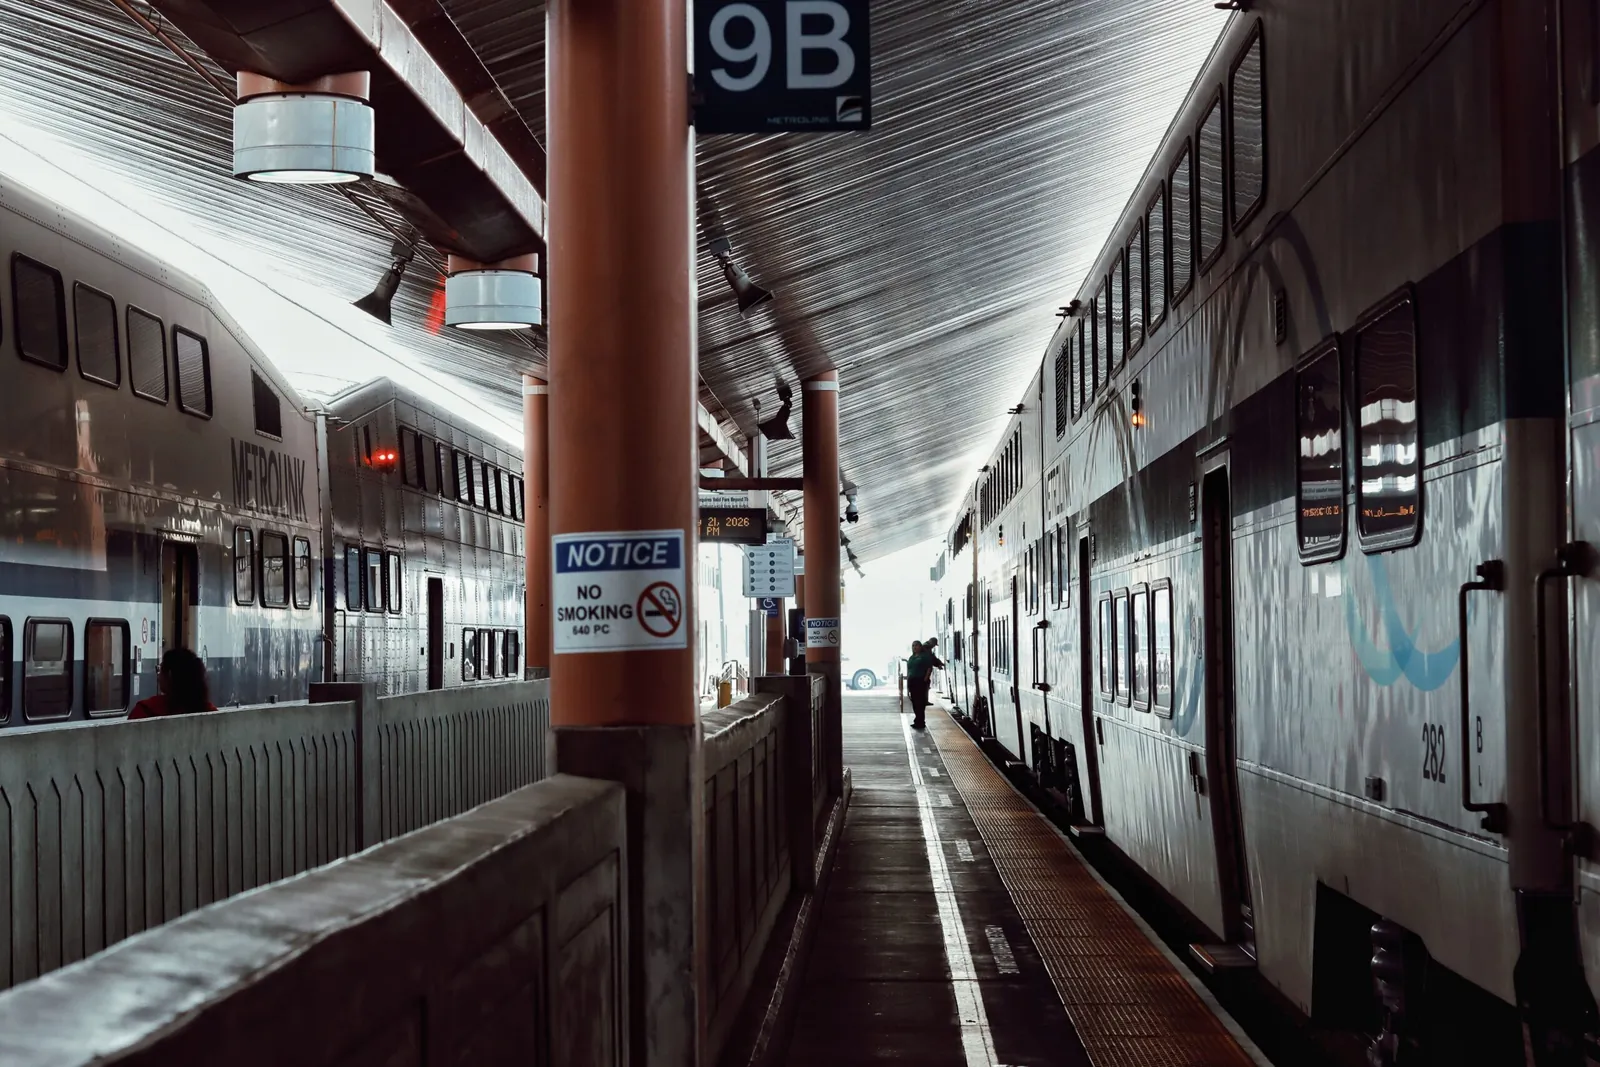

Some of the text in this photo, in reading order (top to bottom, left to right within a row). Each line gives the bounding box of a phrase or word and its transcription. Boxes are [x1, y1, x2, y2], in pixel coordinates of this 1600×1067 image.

[709, 0, 855, 92] 9B
[766, 116, 830, 125] METROLINK
[231, 437, 308, 522] METROLINK
[725, 516, 750, 527] 2026
[706, 526, 720, 536] PM
[567, 541, 669, 567] NOTICE
[577, 585, 602, 600] NO
[557, 604, 634, 621] SMOKING
[572, 624, 610, 635] 640 PC
[1476, 715, 1483, 754] B
[1422, 722, 1446, 784] 282
